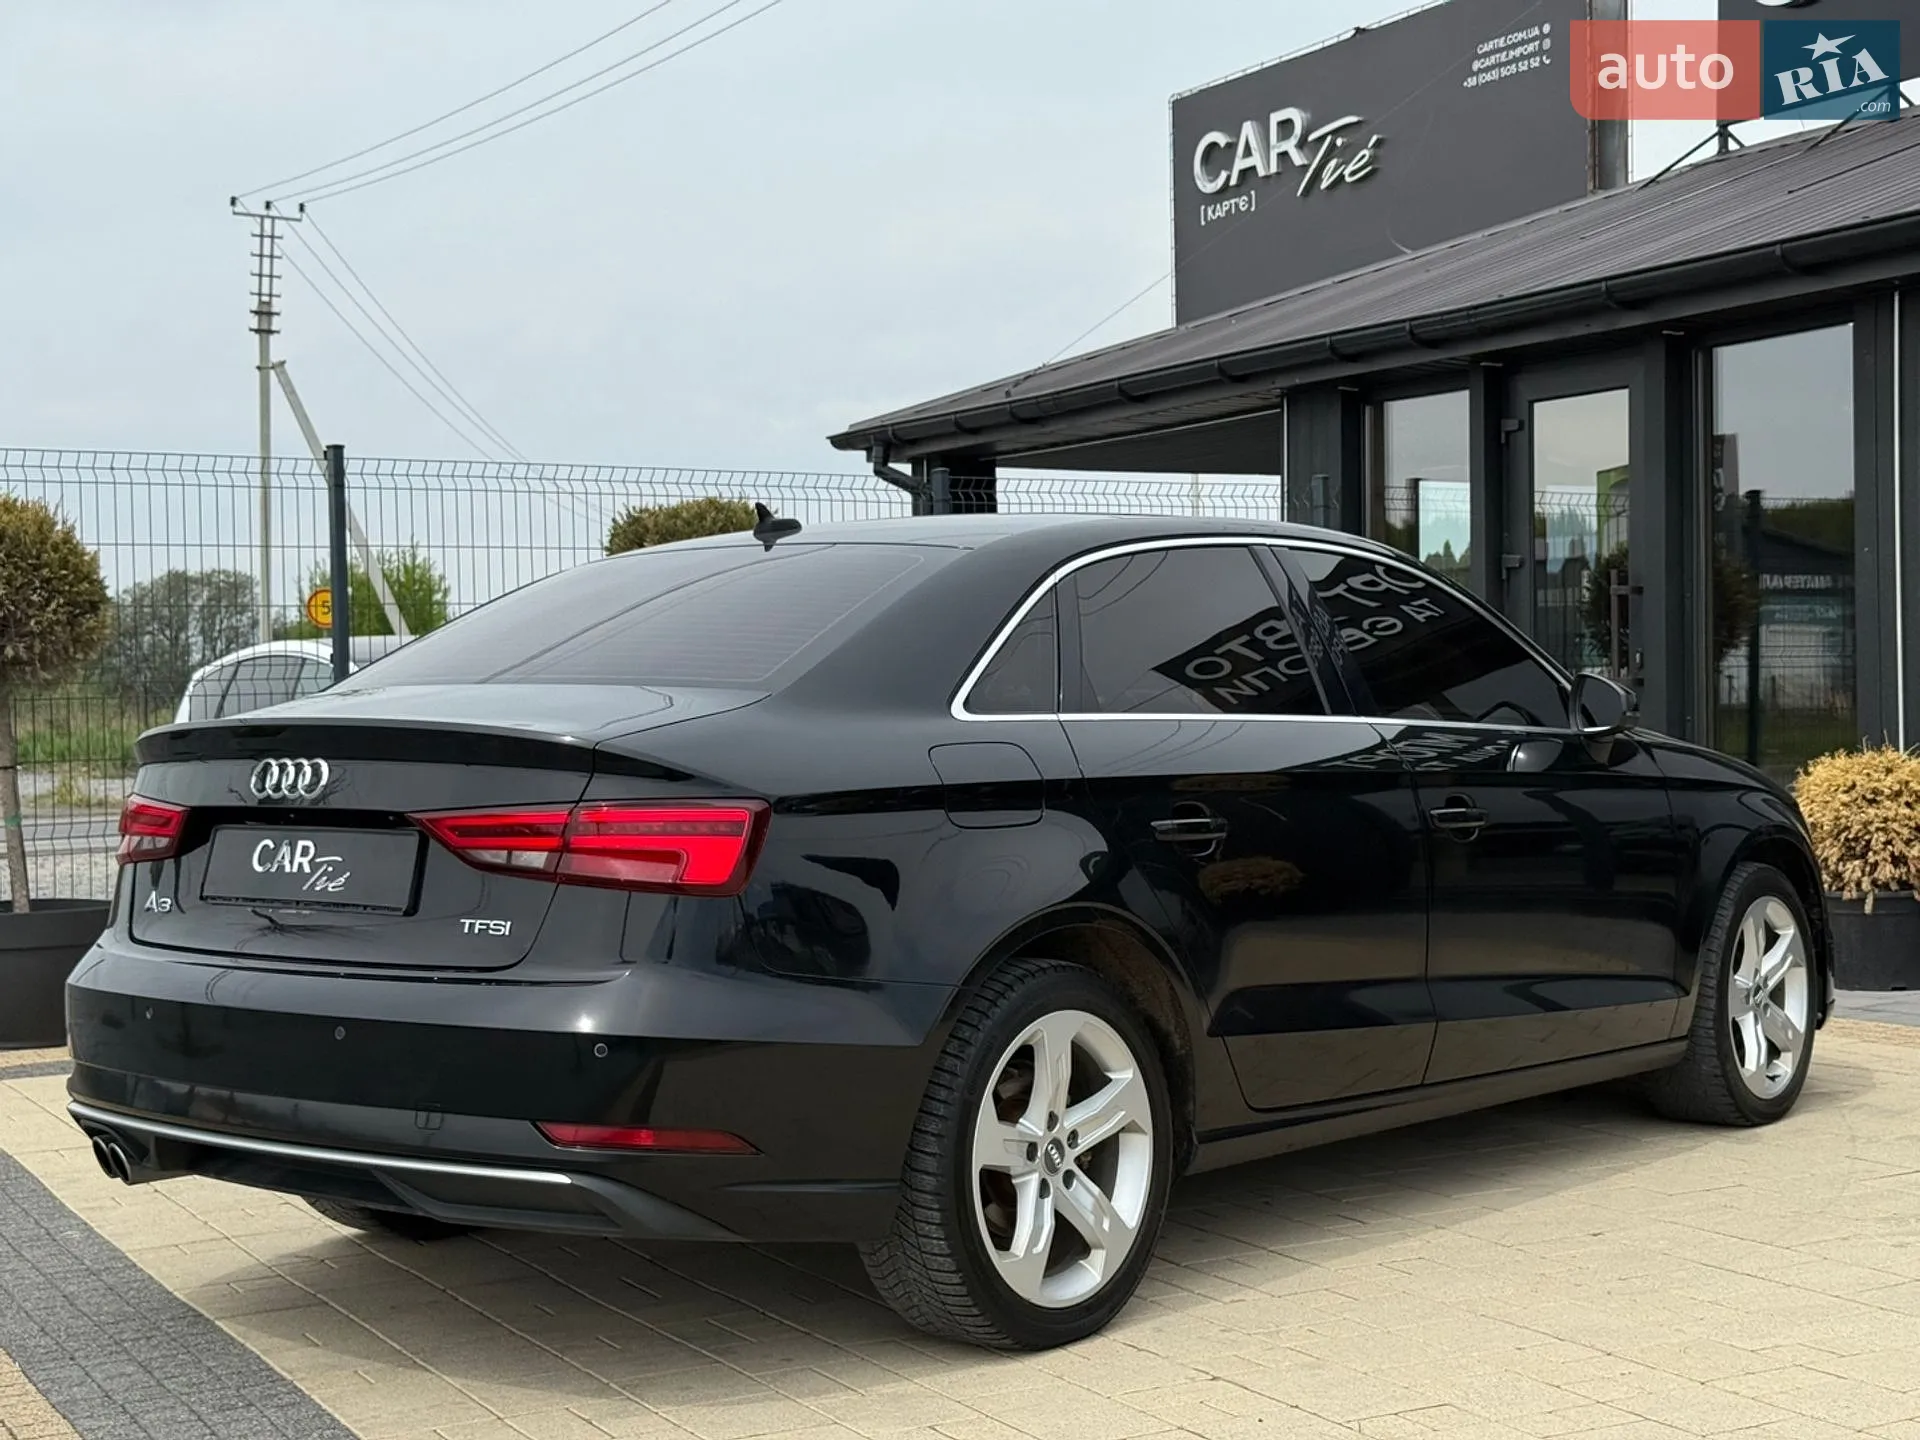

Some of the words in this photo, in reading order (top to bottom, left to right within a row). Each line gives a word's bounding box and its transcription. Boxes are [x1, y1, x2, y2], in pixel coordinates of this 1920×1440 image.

[1477, 25, 1541, 54] CARTIE.COM.UA
[1472, 40, 1541, 72] @CARTIE.IMPORT
[1193, 106, 1310, 194] CAR
[252, 838, 316, 873] CAR
[144, 890, 172, 913] A3
[460, 918, 512, 936] TFSI
